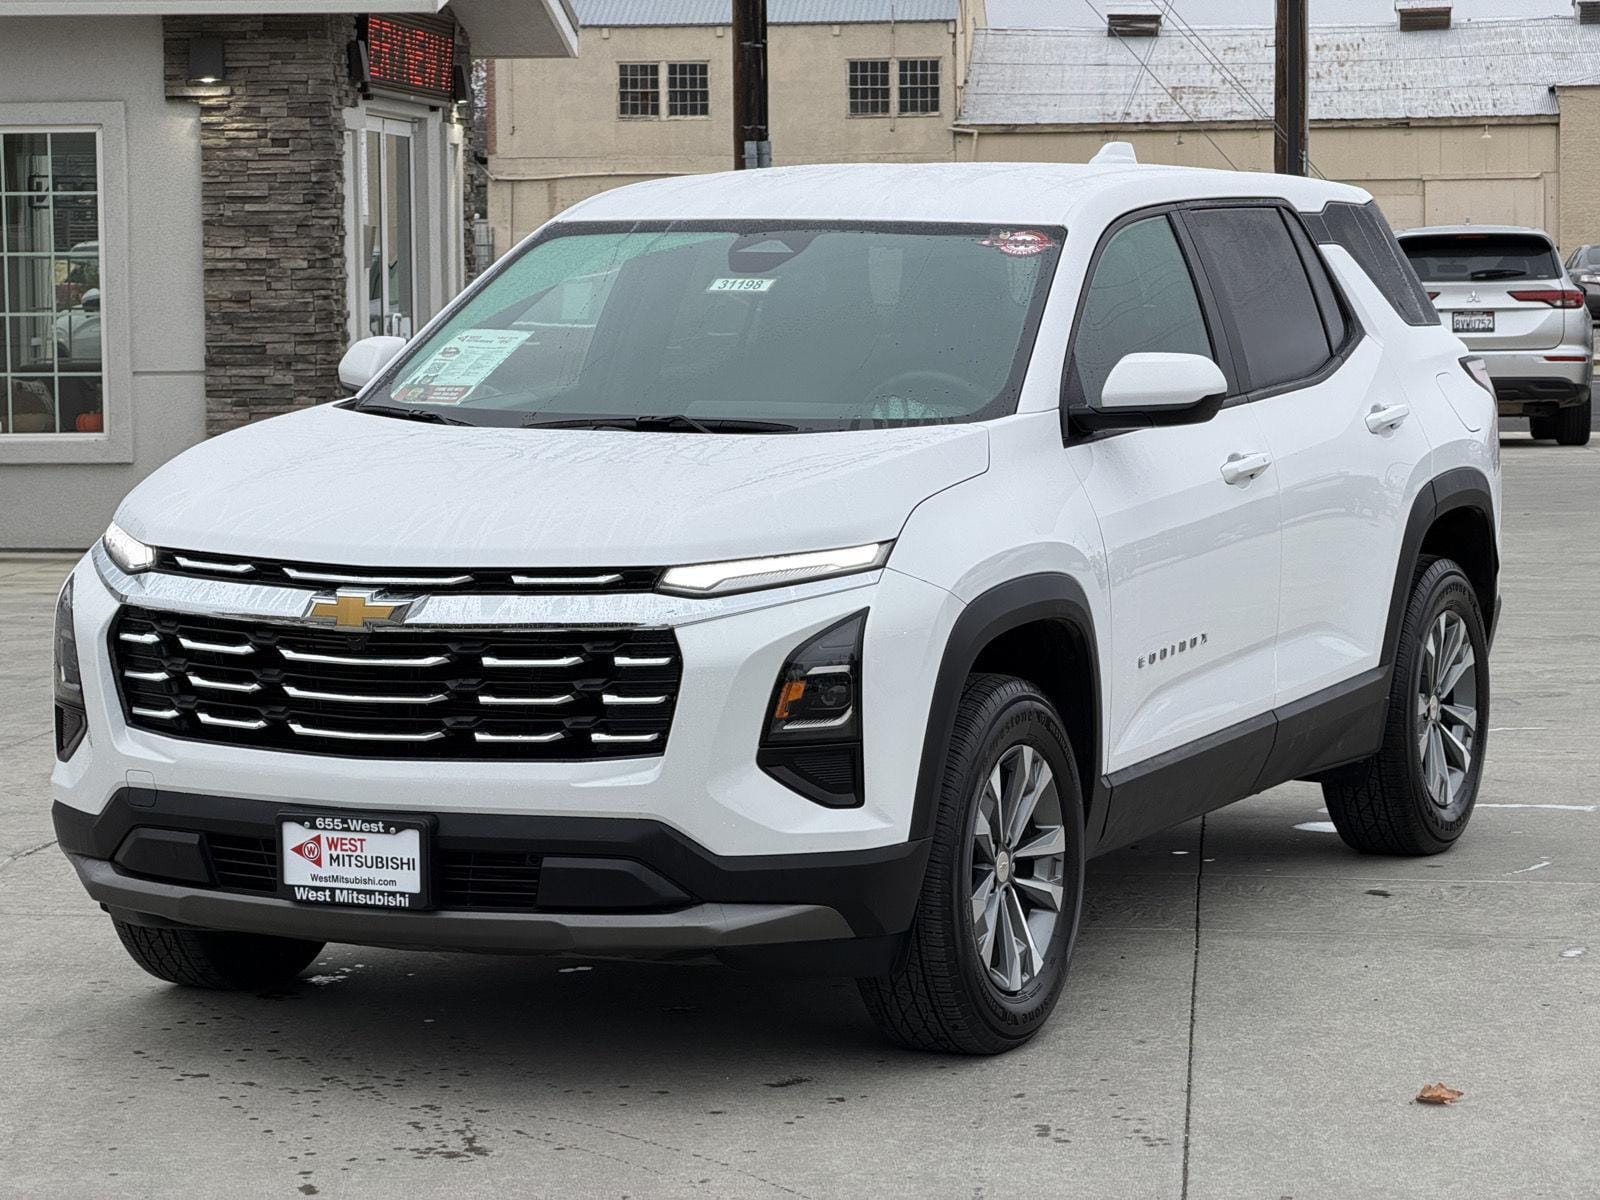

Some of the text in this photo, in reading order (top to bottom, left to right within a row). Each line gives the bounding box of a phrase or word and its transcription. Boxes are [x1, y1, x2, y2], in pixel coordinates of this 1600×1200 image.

[718, 279, 764, 290] 31198
[315, 817, 385, 833] 655-West
[326, 837, 366, 853] WEST
[329, 853, 416, 871] MITSUBISHI
[310, 873, 397, 887] WestMitsubishi.com
[294, 887, 409, 907] West Mitsubishi
